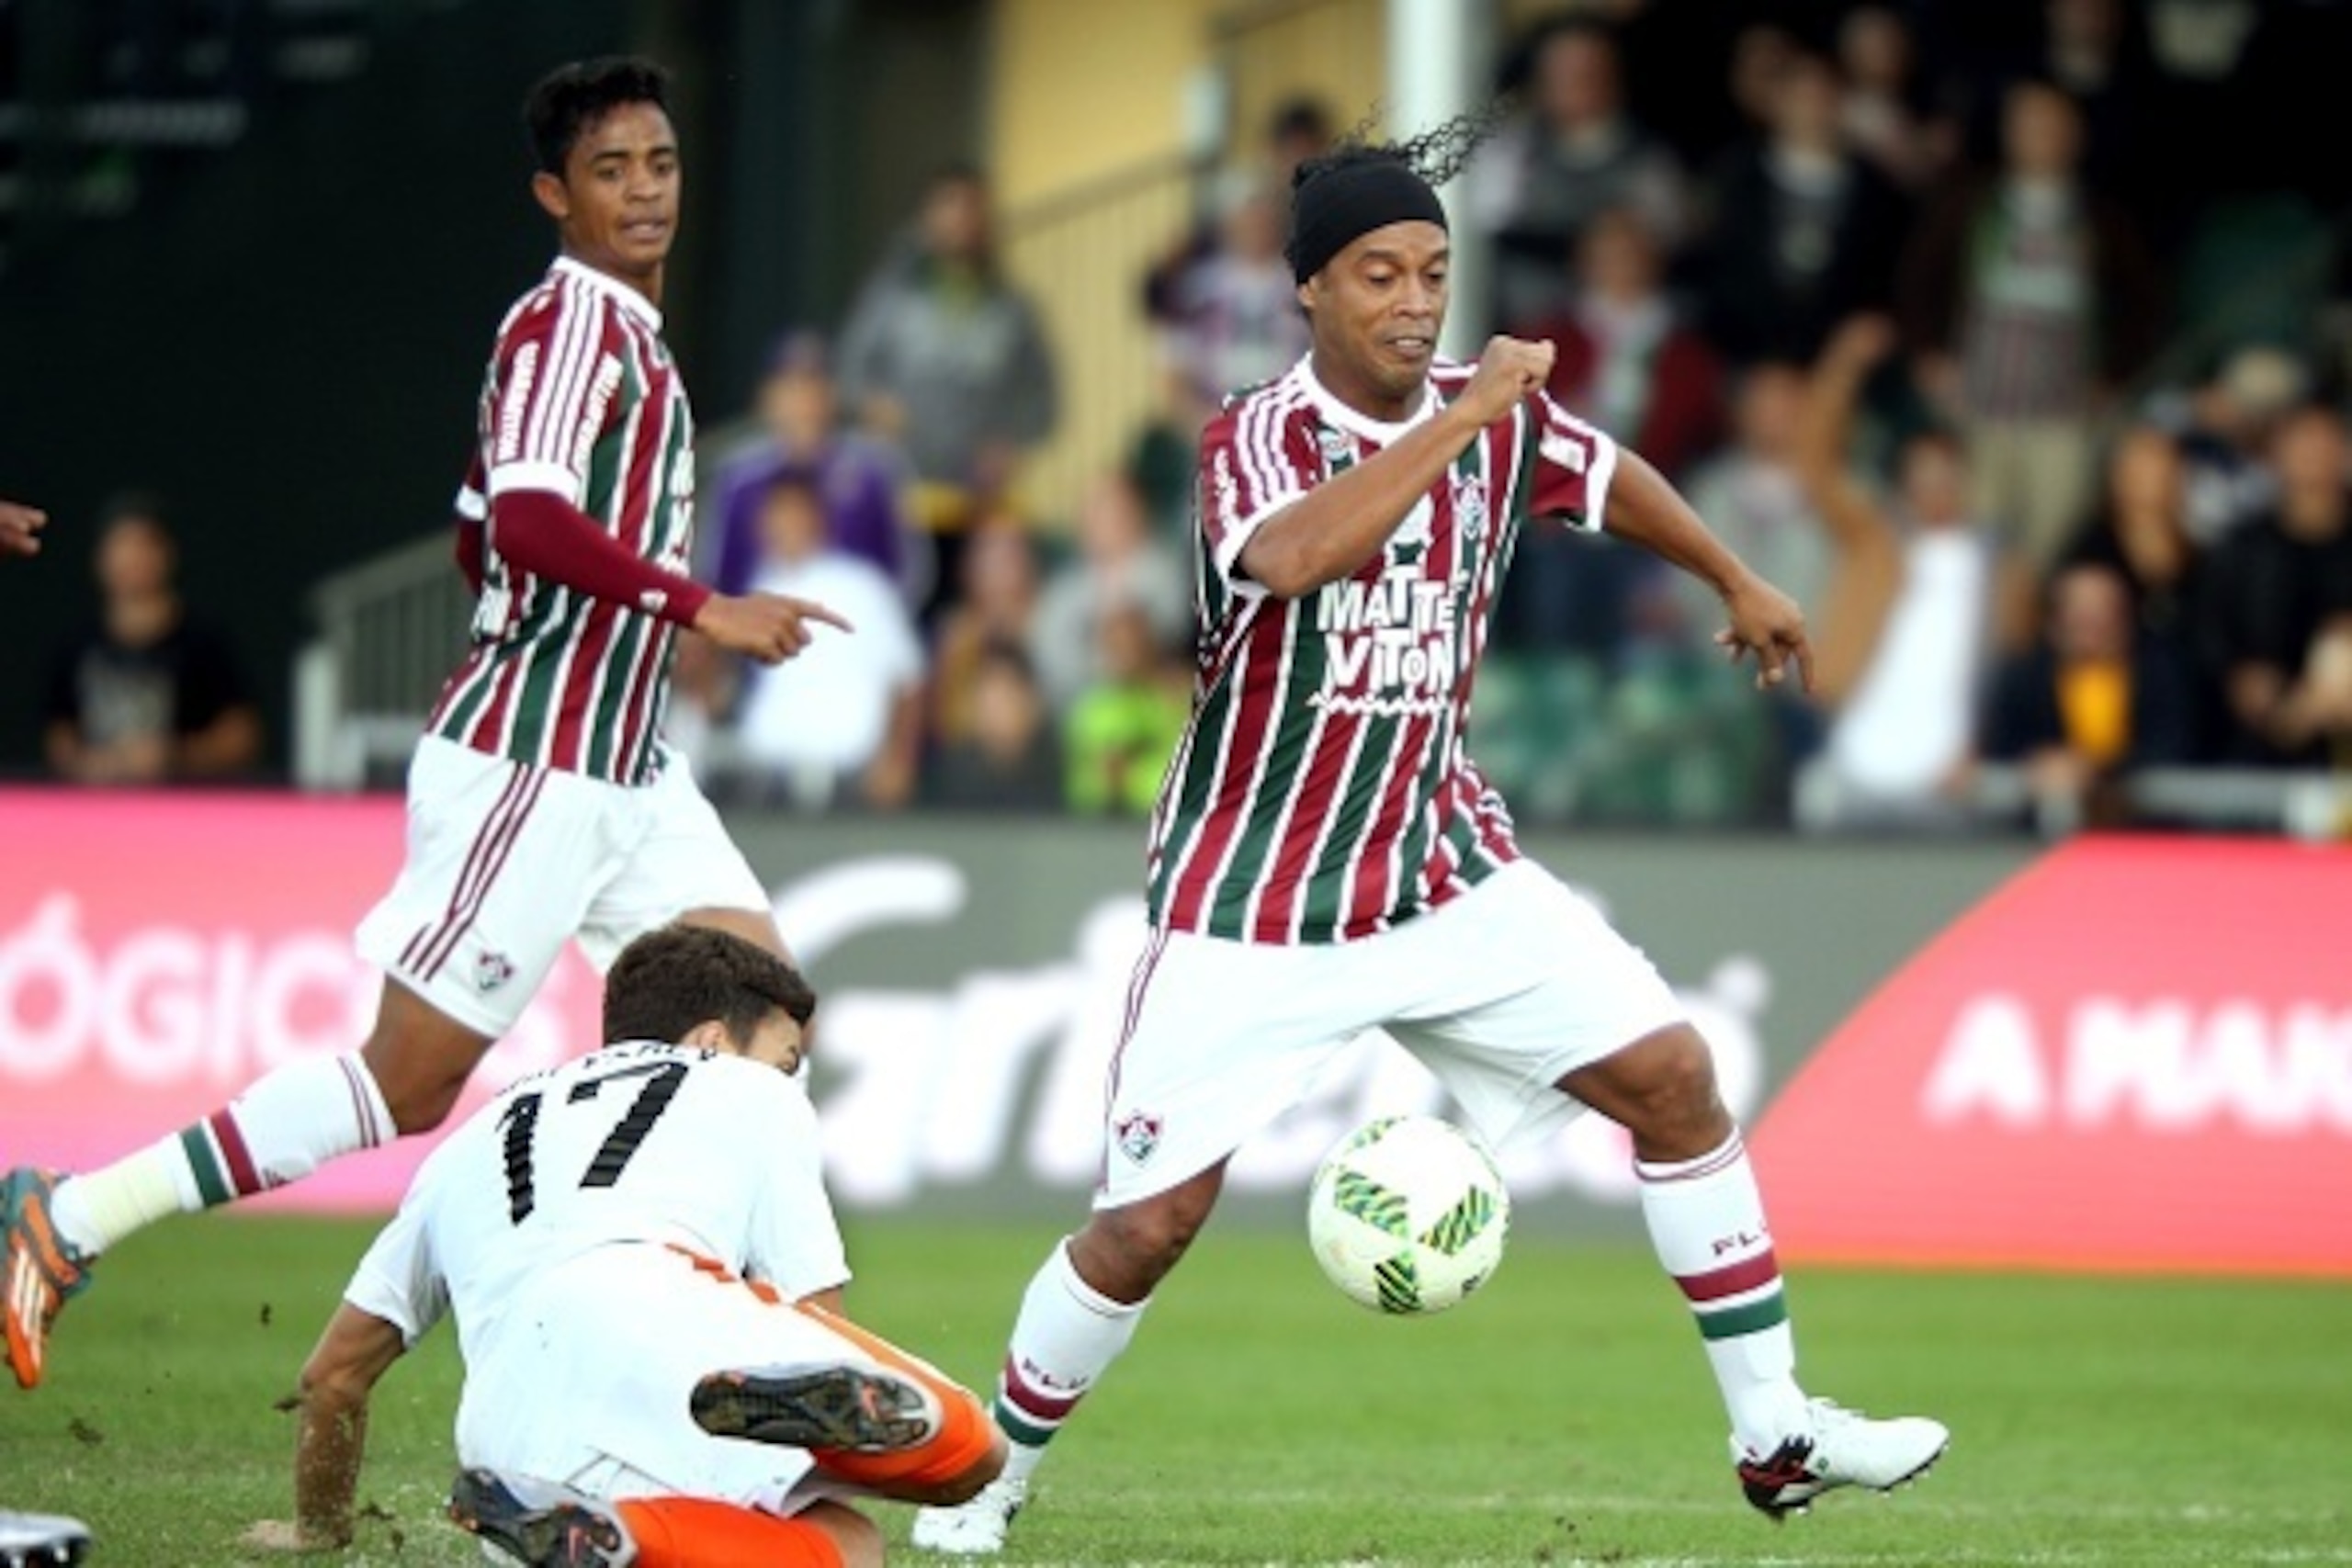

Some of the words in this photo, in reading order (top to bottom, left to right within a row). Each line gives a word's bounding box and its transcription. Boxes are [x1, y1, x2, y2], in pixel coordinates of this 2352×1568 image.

[1317, 564, 1456, 634] MATTE
[1324, 627, 1455, 692] VITON
[1923, 996, 2049, 1130] A
[494, 1091, 690, 1227] 17
